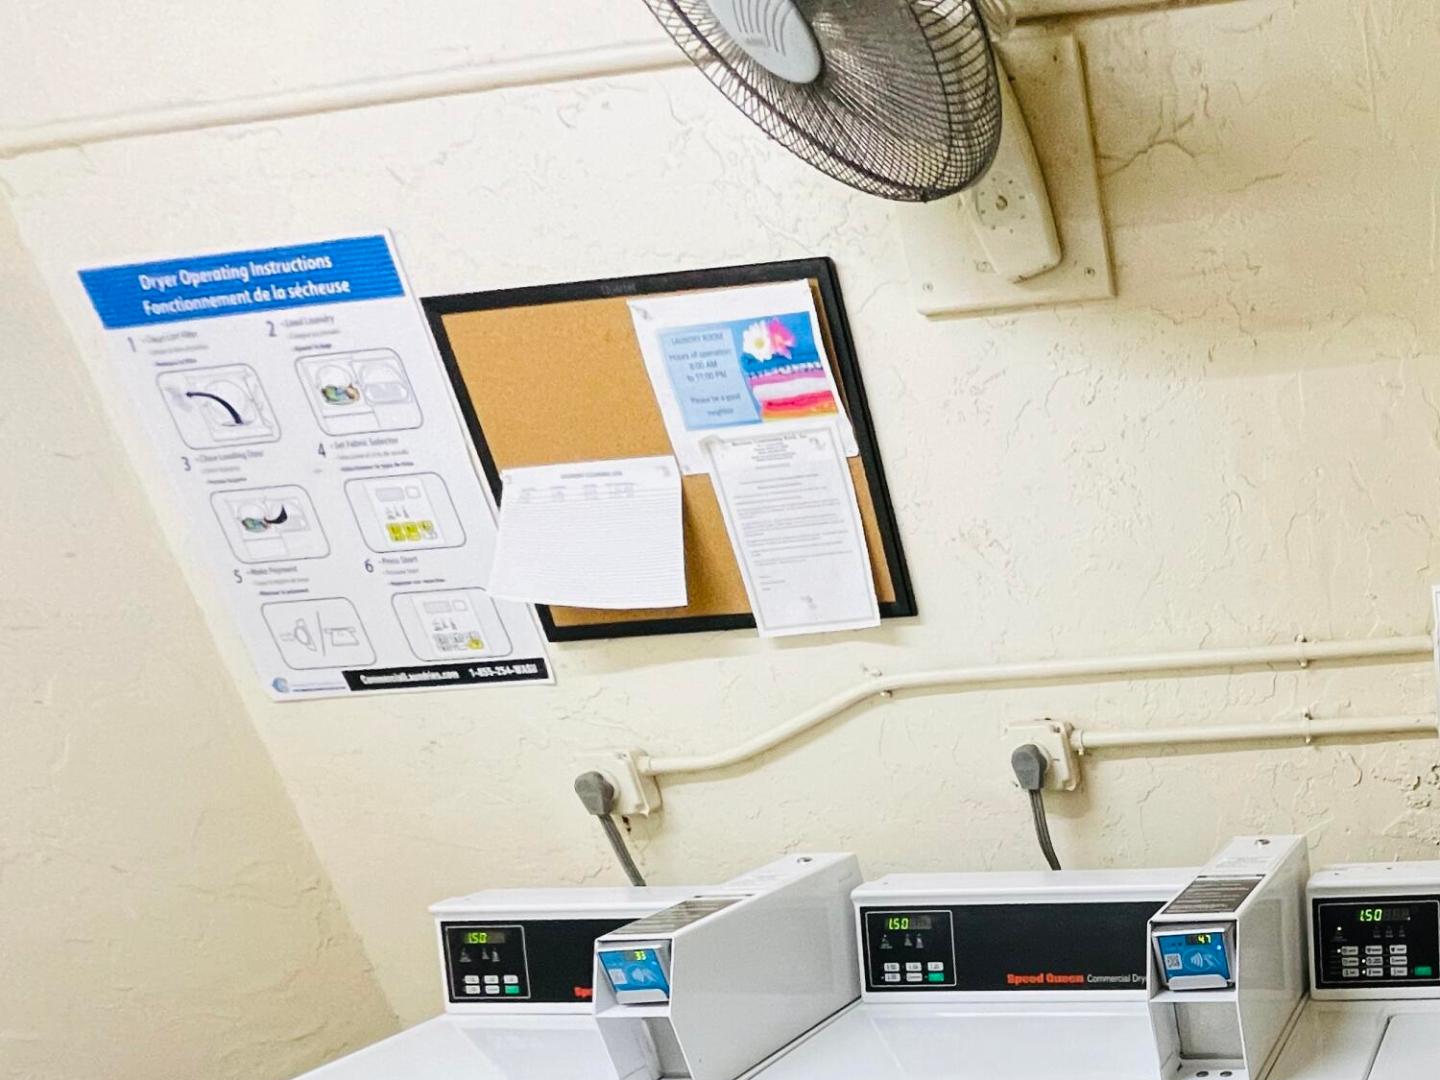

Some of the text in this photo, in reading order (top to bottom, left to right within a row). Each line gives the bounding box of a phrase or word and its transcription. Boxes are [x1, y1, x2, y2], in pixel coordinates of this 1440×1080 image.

[138, 254, 333, 292] Dryer Operating Instructions
[143, 279, 350, 316] Fonctionnement de la sécheuse
[266, 320, 277, 337] 2
[127, 336, 136, 353] 1
[706, 360, 718, 369] AM
[715, 370, 728, 379] PM
[318, 442, 326, 457] 4
[181, 456, 191, 472] 3
[364, 558, 374, 573] 6
[233, 569, 243, 584] 5
[1196, 934, 1212, 944] 47
[1007, 971, 1147, 986] Speed Queen Commercial Dry
